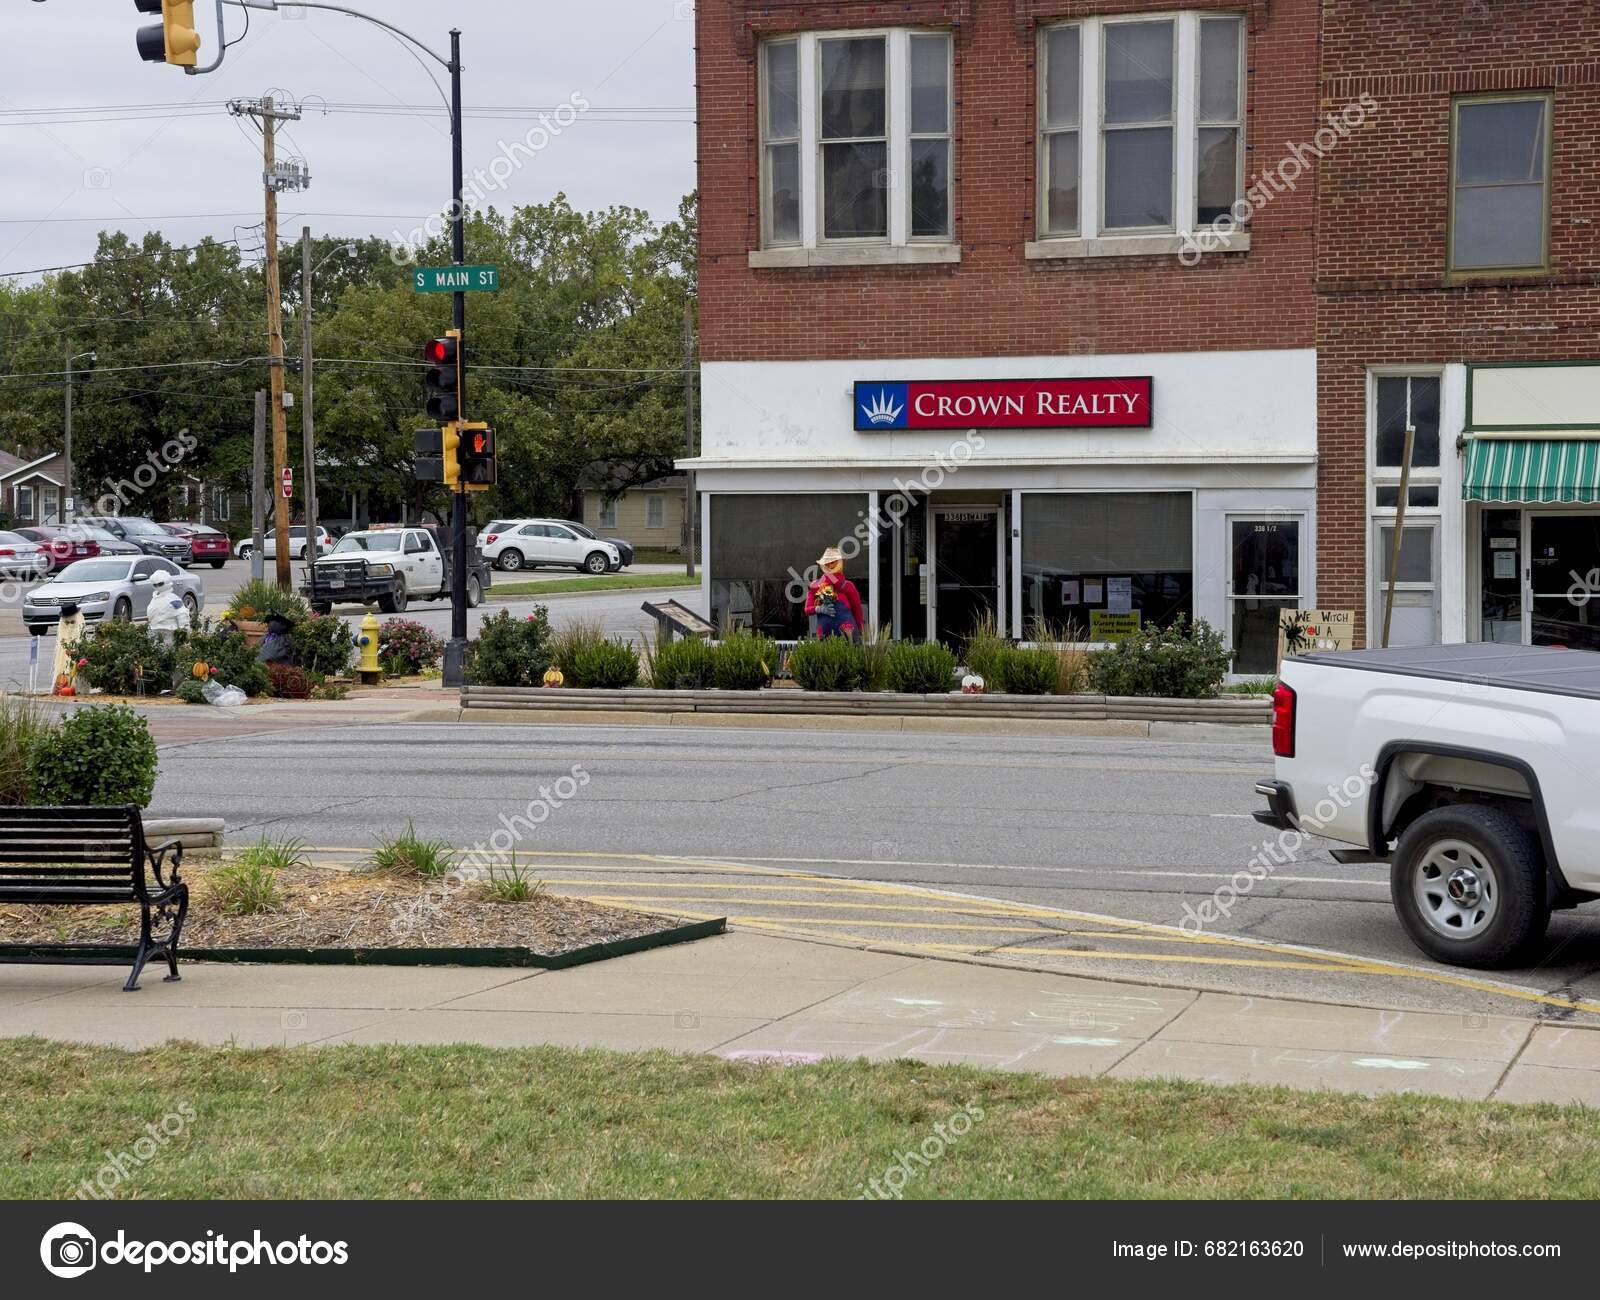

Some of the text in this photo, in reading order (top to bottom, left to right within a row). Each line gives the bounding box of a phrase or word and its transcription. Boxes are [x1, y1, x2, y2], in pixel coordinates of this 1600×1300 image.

[417, 271, 494, 287] S MAIN ST
[914, 391, 1141, 417] CROWN REALTY
[1295, 611, 1349, 622] WE WITCH
[1327, 626, 1333, 637] A
[1304, 638, 1341, 651] HAY
